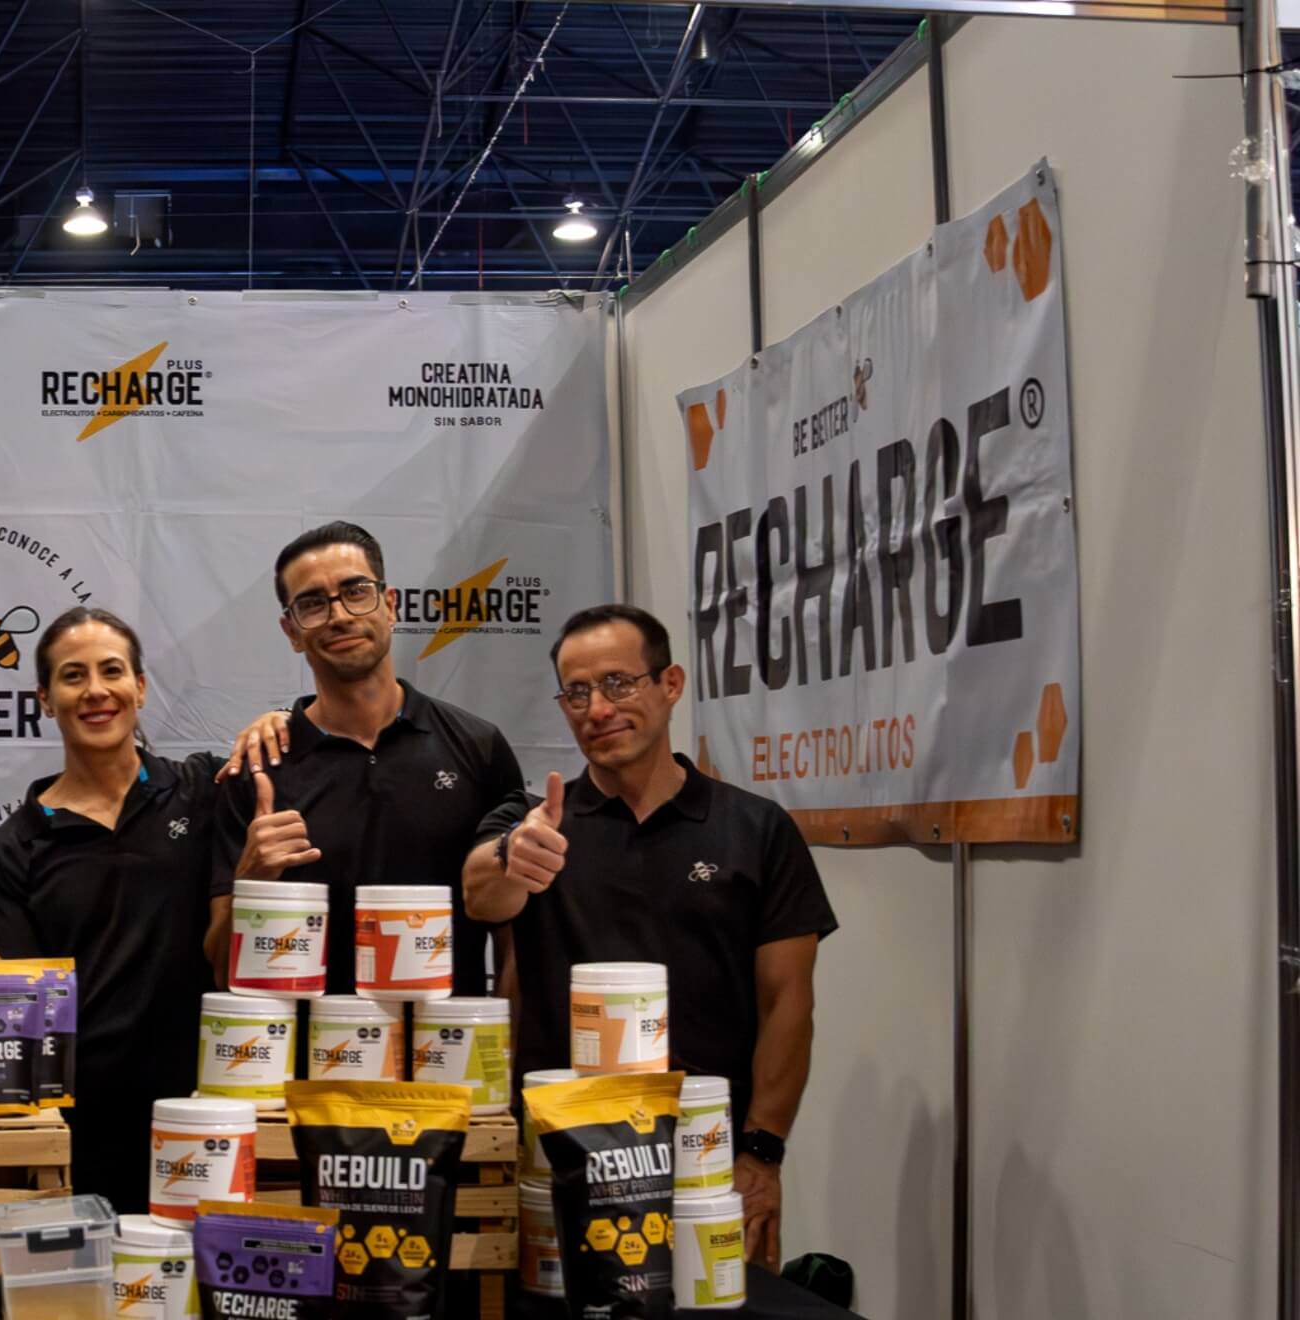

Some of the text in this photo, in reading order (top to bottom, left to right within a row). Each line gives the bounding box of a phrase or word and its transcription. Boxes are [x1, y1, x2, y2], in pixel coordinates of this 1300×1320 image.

[167, 360, 203, 370] PLUS
[422, 363, 511, 384] CREATINA
[388, 386, 544, 409] MONOHIDRATADA
[434, 417, 502, 426] SIN SABOR
[793, 395, 849, 457] BE BETTER
[59, 568, 73, 580] A
[71, 581, 92, 604] LA
[506, 577, 541, 587] PLUS
[753, 714, 916, 782] ELECTROLITOS
[254, 937, 310, 952] RECHARGE
[215, 1044, 271, 1060] RECHARGE
[318, 1154, 426, 1190] REBUILD
[587, 1143, 671, 1184] REBUILD
